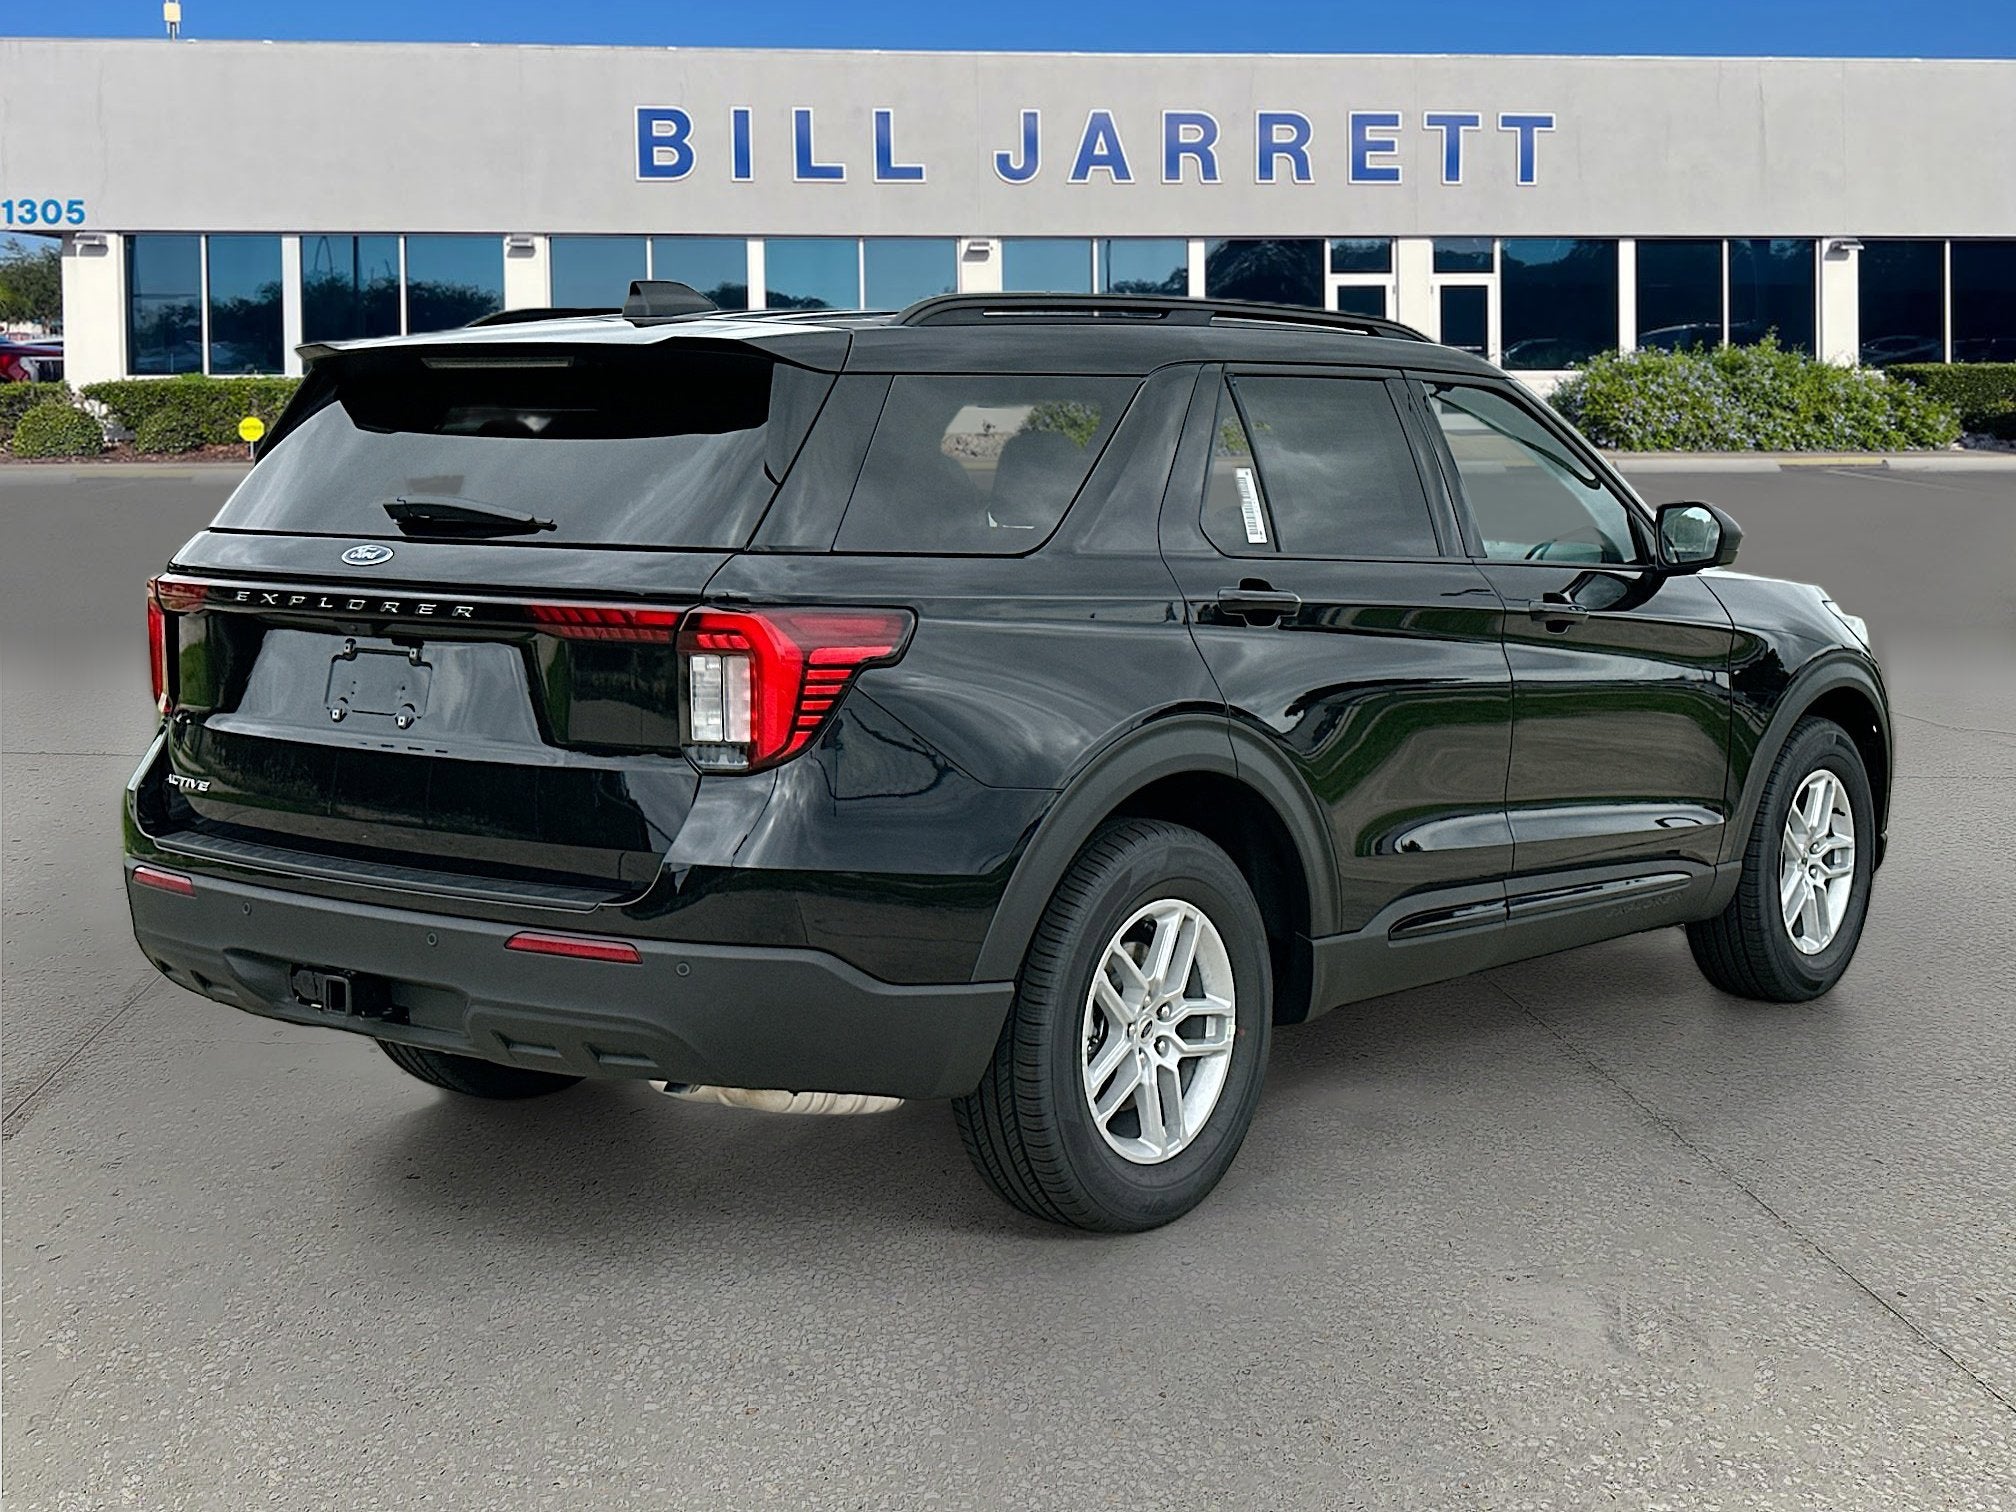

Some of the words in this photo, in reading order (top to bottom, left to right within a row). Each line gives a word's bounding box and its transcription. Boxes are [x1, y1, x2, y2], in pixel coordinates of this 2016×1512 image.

[635, 105, 926, 183] BILL
[993, 109, 1556, 186] JARRETT
[1, 199, 86, 225] 1305
[349, 545, 382, 560] Ford
[235, 590, 474, 618] EXPLORER
